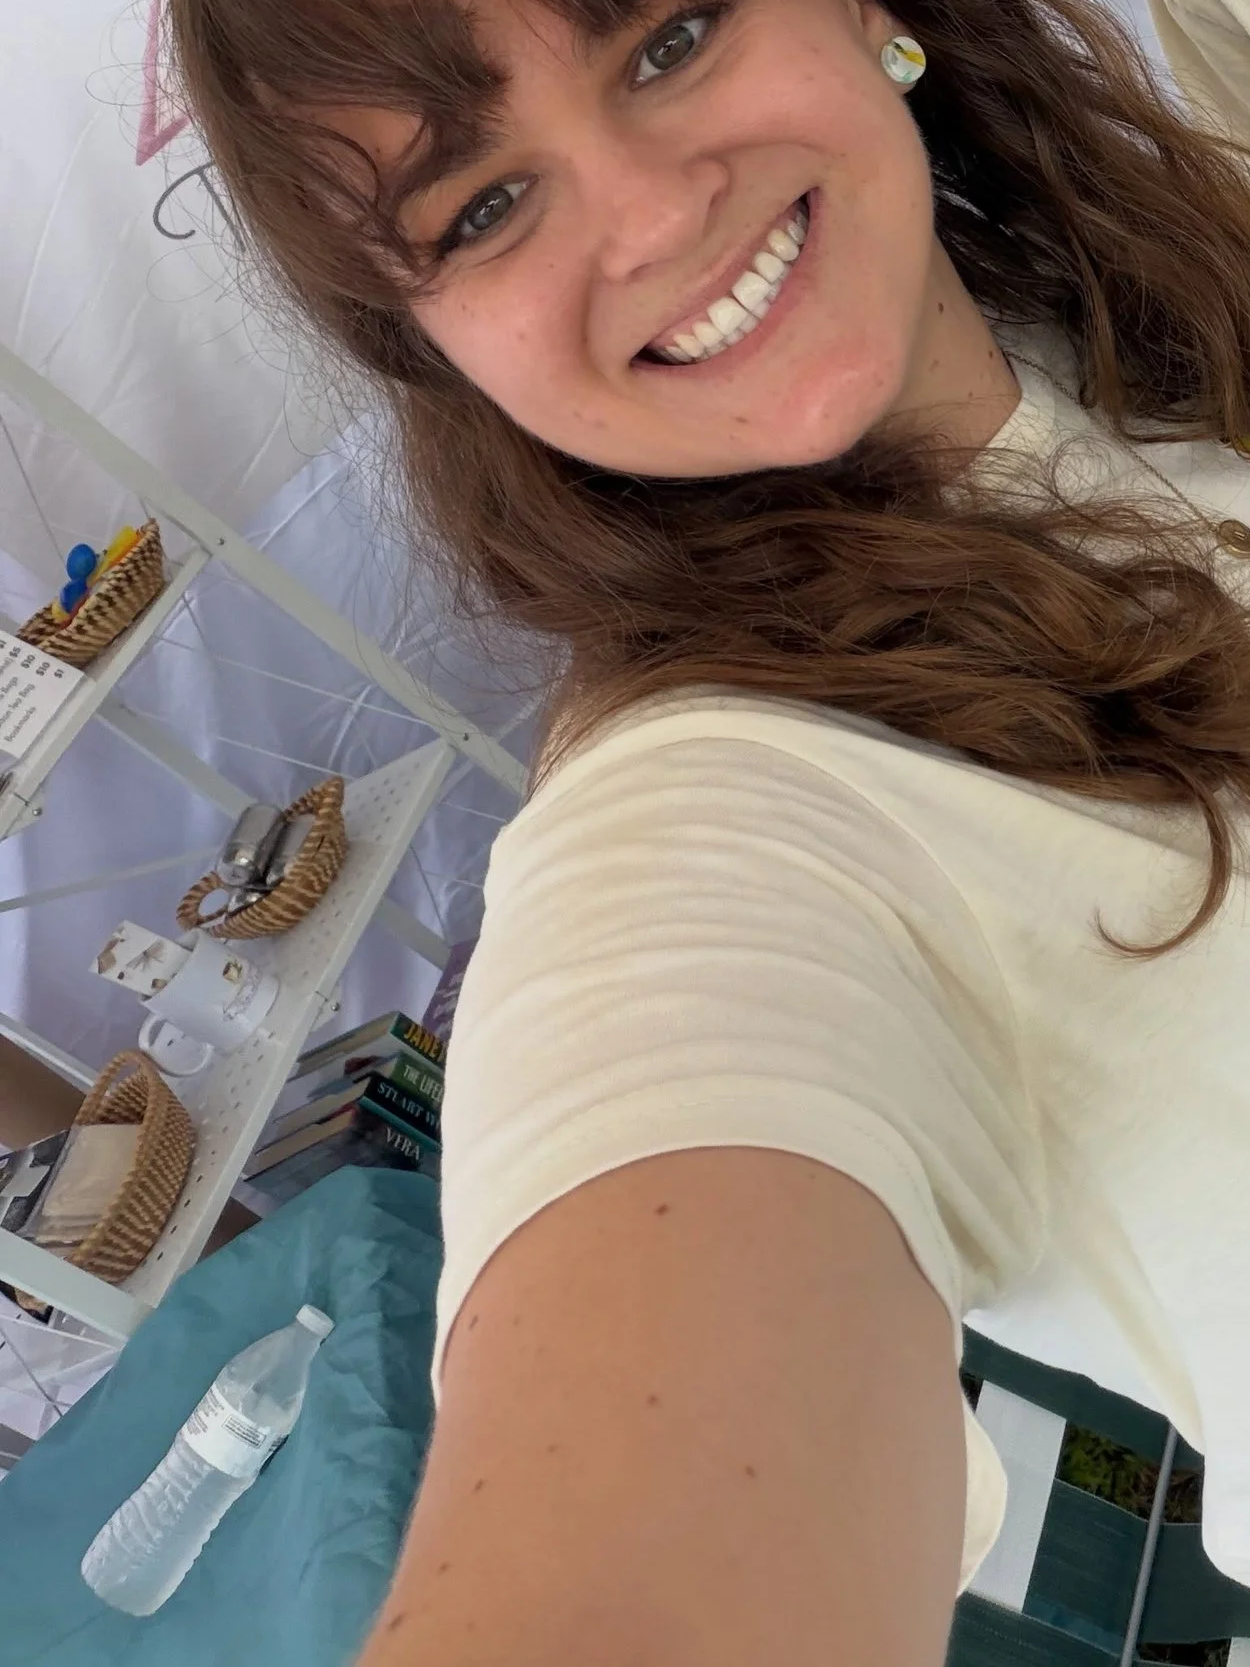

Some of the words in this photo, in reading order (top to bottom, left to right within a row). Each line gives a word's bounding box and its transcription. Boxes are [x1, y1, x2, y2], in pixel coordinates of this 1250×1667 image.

[9, 646, 21, 659] $5
[20, 654, 36, 669] $10
[35, 661, 51, 677] $10
[5, 706, 36, 742] Bookmarks
[54, 669, 65, 679] $1
[376, 1081, 425, 1118] STUART
[403, 1063, 420, 1080] THE
[420, 1067, 443, 1102] LIFE
[385, 1126, 422, 1161] VERA
